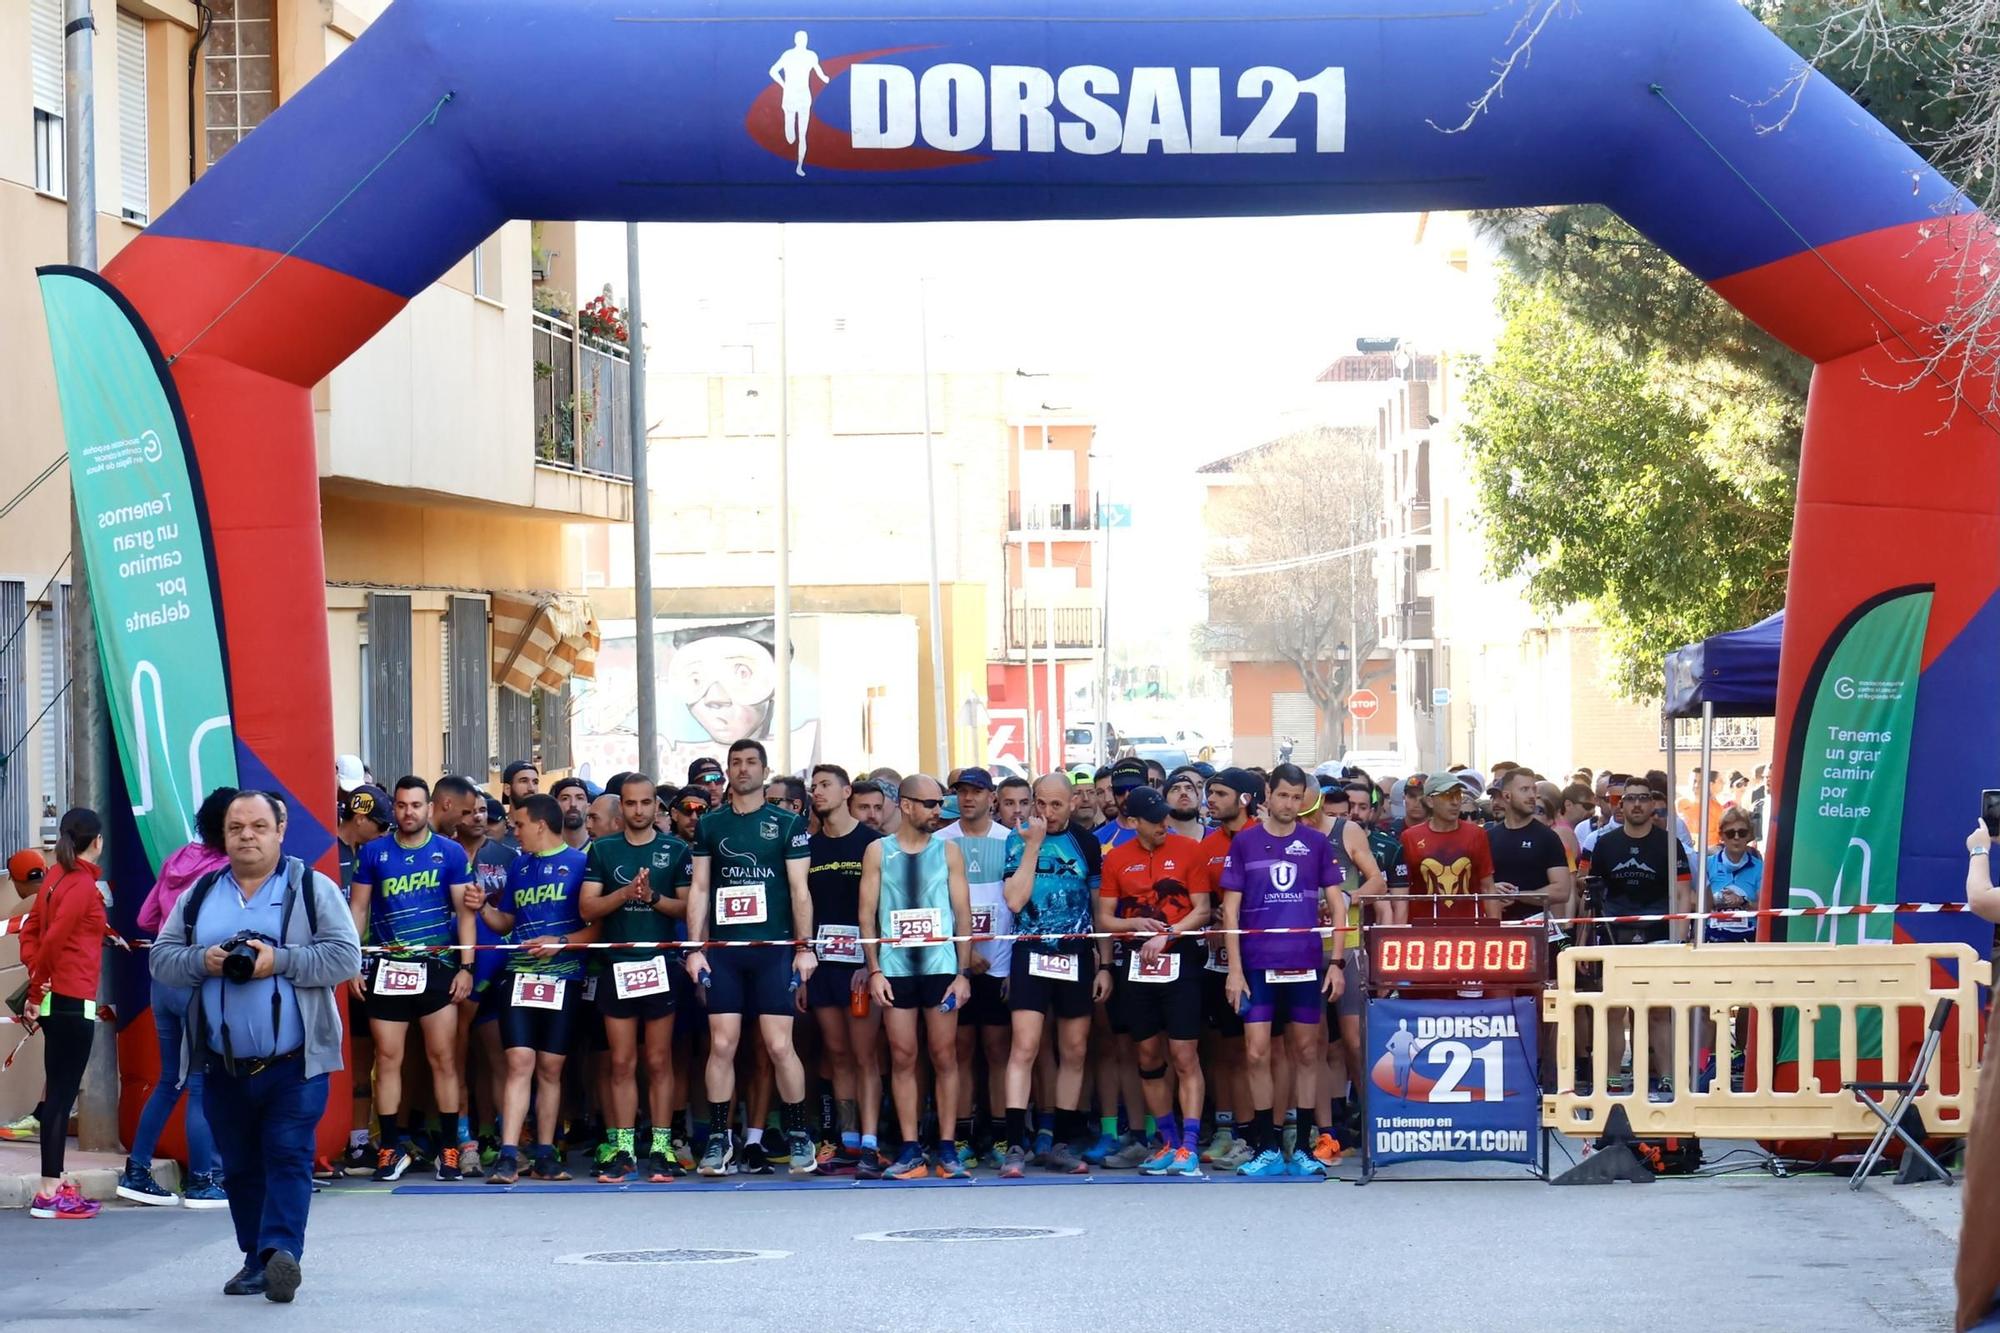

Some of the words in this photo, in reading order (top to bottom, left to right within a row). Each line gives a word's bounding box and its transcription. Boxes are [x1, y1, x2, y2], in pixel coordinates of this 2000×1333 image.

[850, 62, 1346, 155] DORSAL21
[1825, 748, 1845, 760] un
[1820, 786, 1847, 801] por
[721, 866, 775, 879] CATALINA
[382, 869, 440, 898] RAFAL
[514, 882, 567, 908] RAFAL
[731, 899, 751, 912] 87
[902, 920, 932, 934] 259
[1040, 955, 1069, 969] 140
[388, 972, 418, 986] 198
[626, 969, 658, 986] 292
[533, 984, 545, 997] 6
[1417, 1015, 1519, 1039] DORSAL
[1428, 1040, 1504, 1103] 21
[1376, 1117, 1391, 1128] Tu
[1392, 1117, 1435, 1129] tiempo
[1436, 1118, 1453, 1128] en
[1376, 1129, 1528, 1153] DORSAL21.COM
